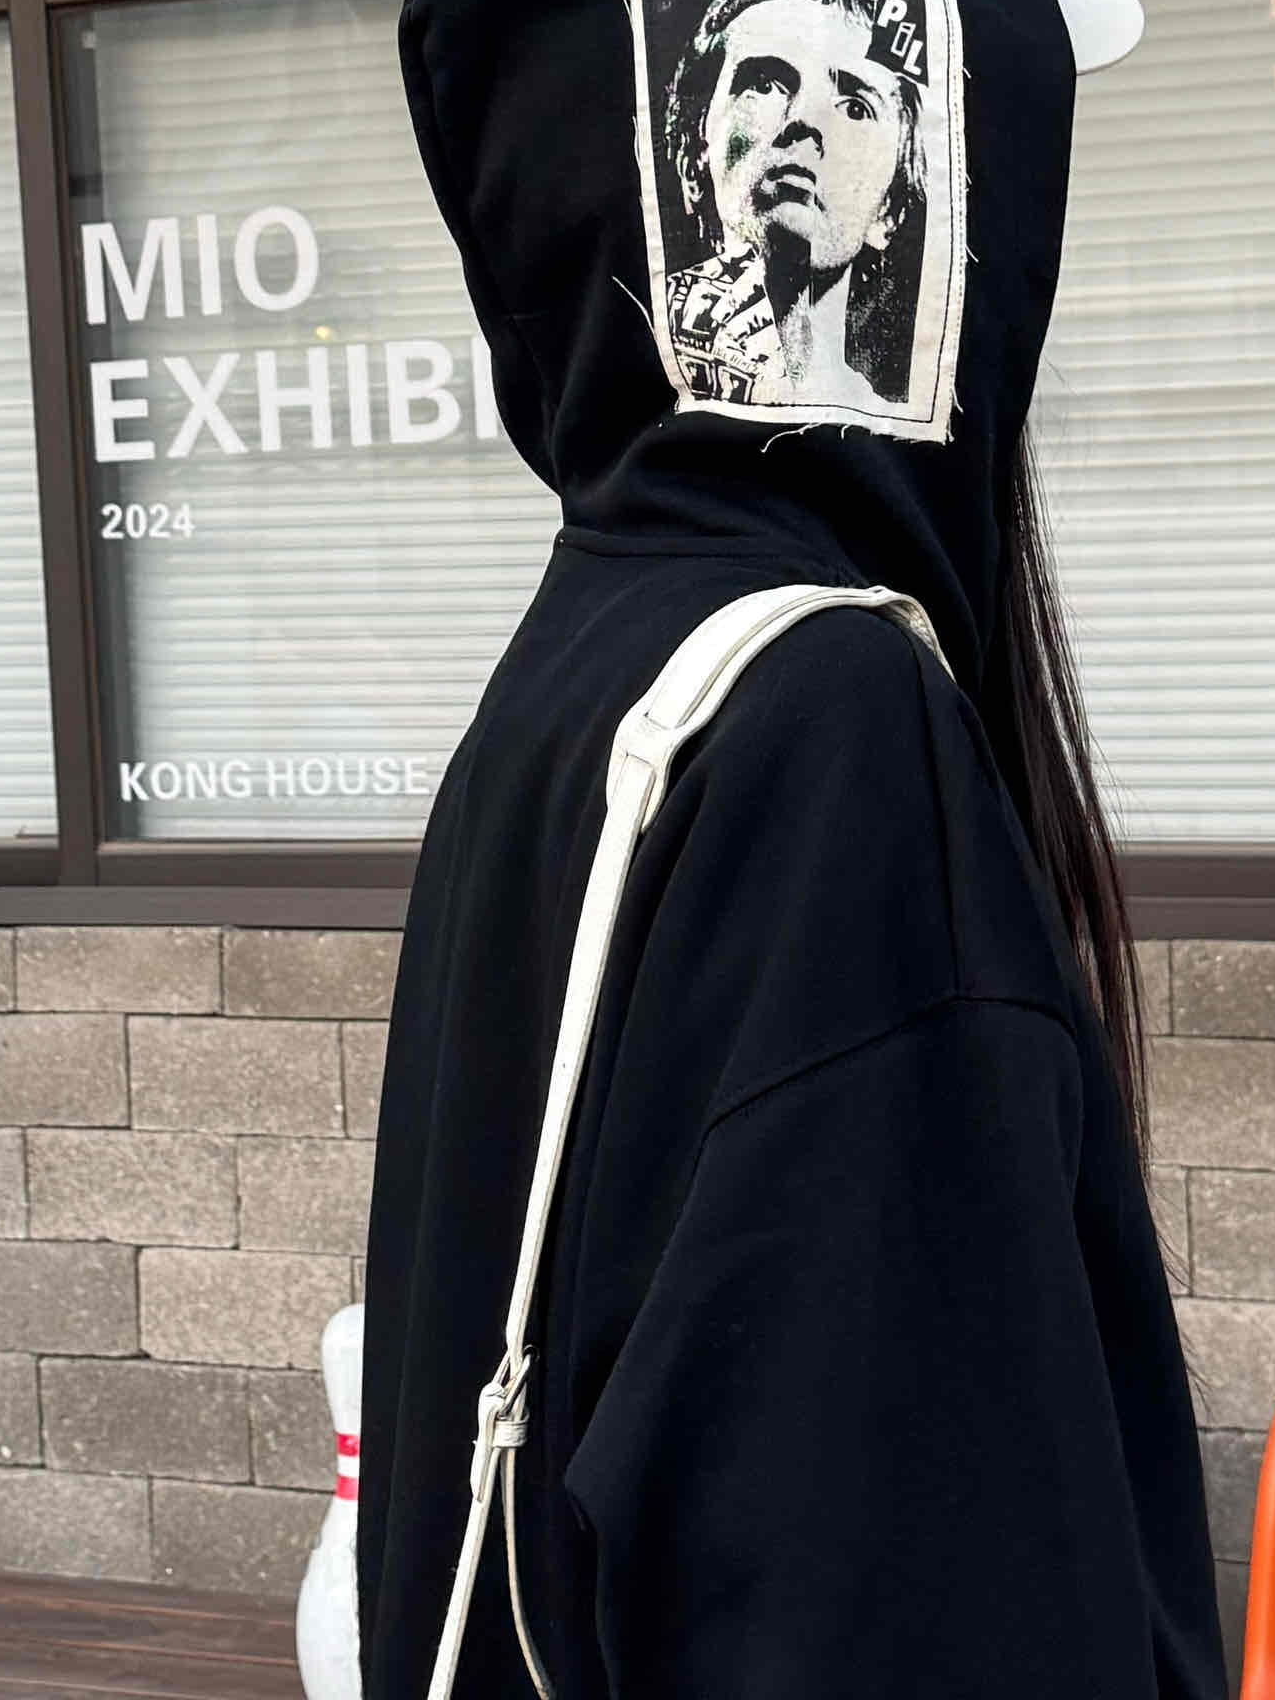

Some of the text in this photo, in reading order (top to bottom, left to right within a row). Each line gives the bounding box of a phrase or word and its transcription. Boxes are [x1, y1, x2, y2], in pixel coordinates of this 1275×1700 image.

[82, 205, 320, 325] MIO
[101, 503, 196, 540] 2024
[119, 756, 431, 802] KONG HOUSE
